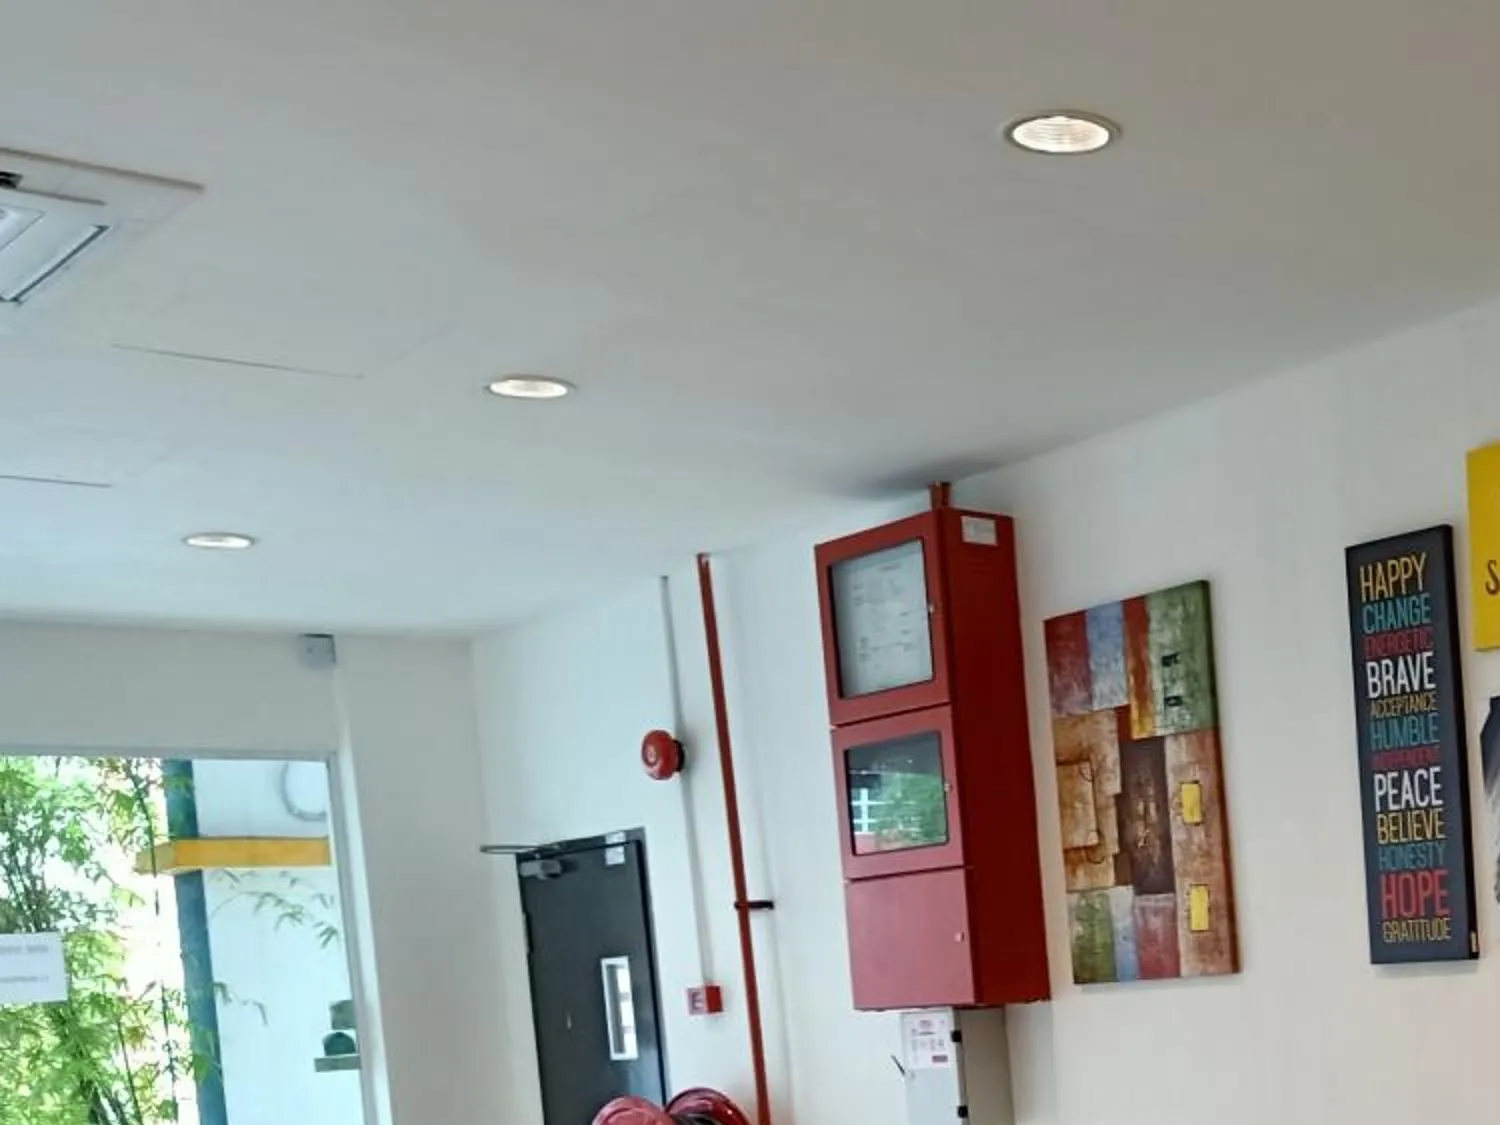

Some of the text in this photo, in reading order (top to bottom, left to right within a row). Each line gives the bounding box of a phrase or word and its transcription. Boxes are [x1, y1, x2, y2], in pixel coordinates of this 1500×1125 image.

[1360, 552, 1427, 602] HAPPY
[1363, 592, 1431, 635] CHANGE
[1367, 651, 1437, 699] BRAVE
[1371, 691, 1439, 718] ACCEPTANCE
[1371, 712, 1440, 751] HUMBLE
[1375, 766, 1444, 813] PEACE
[1378, 808, 1447, 845] BELIEVE
[1380, 842, 1447, 871] HONESTY
[1381, 869, 1451, 919] HOPE
[1383, 917, 1452, 944] GRATITUDE
